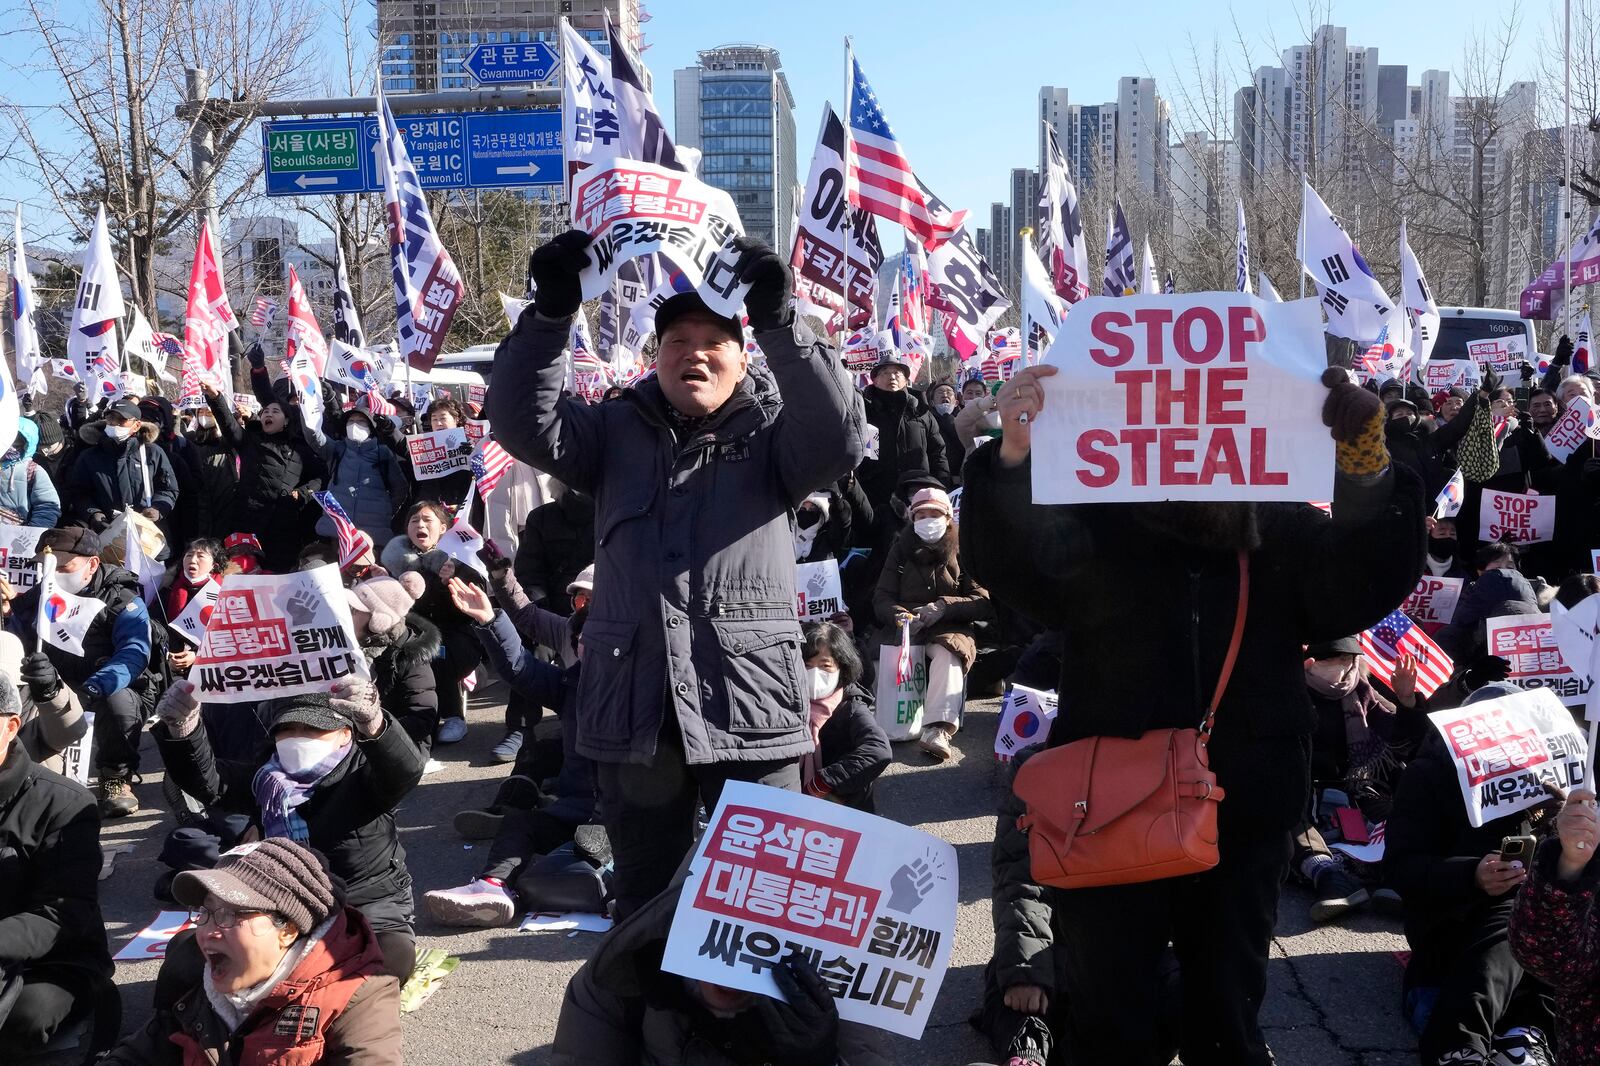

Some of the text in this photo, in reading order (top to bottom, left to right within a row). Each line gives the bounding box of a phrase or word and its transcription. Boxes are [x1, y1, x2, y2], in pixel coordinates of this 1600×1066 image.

[481, 47, 540, 66] 관문로
[479, 68, 545, 80] Gwanmun-ro
[272, 131, 355, 153] 서울(사당)
[410, 139, 461, 152] Yangjae IC
[472, 130, 563, 150] 국가공무원인재개발원
[273, 153, 355, 168] Seoul(Sadang)
[453, 172, 463, 182] IC
[582, 172, 670, 211] 윤석열
[577, 194, 700, 234] 대통령과
[1089, 306, 1266, 367] STOP
[1489, 324, 1515, 334] 1600-2
[1114, 367, 1248, 425] THE
[1551, 410, 1582, 447] STOP
[1076, 427, 1288, 488] STEAL
[1493, 494, 1539, 513] STOP
[1499, 511, 1531, 529] THE
[212, 594, 254, 626] 석열
[807, 596, 839, 616] 함께
[1402, 595, 1433, 610] HE
[291, 625, 348, 654] 함께
[200, 652, 357, 693] 싸우겠습니다
[719, 813, 844, 879] 윤석열
[705, 863, 942, 970] 대통령과 함께
